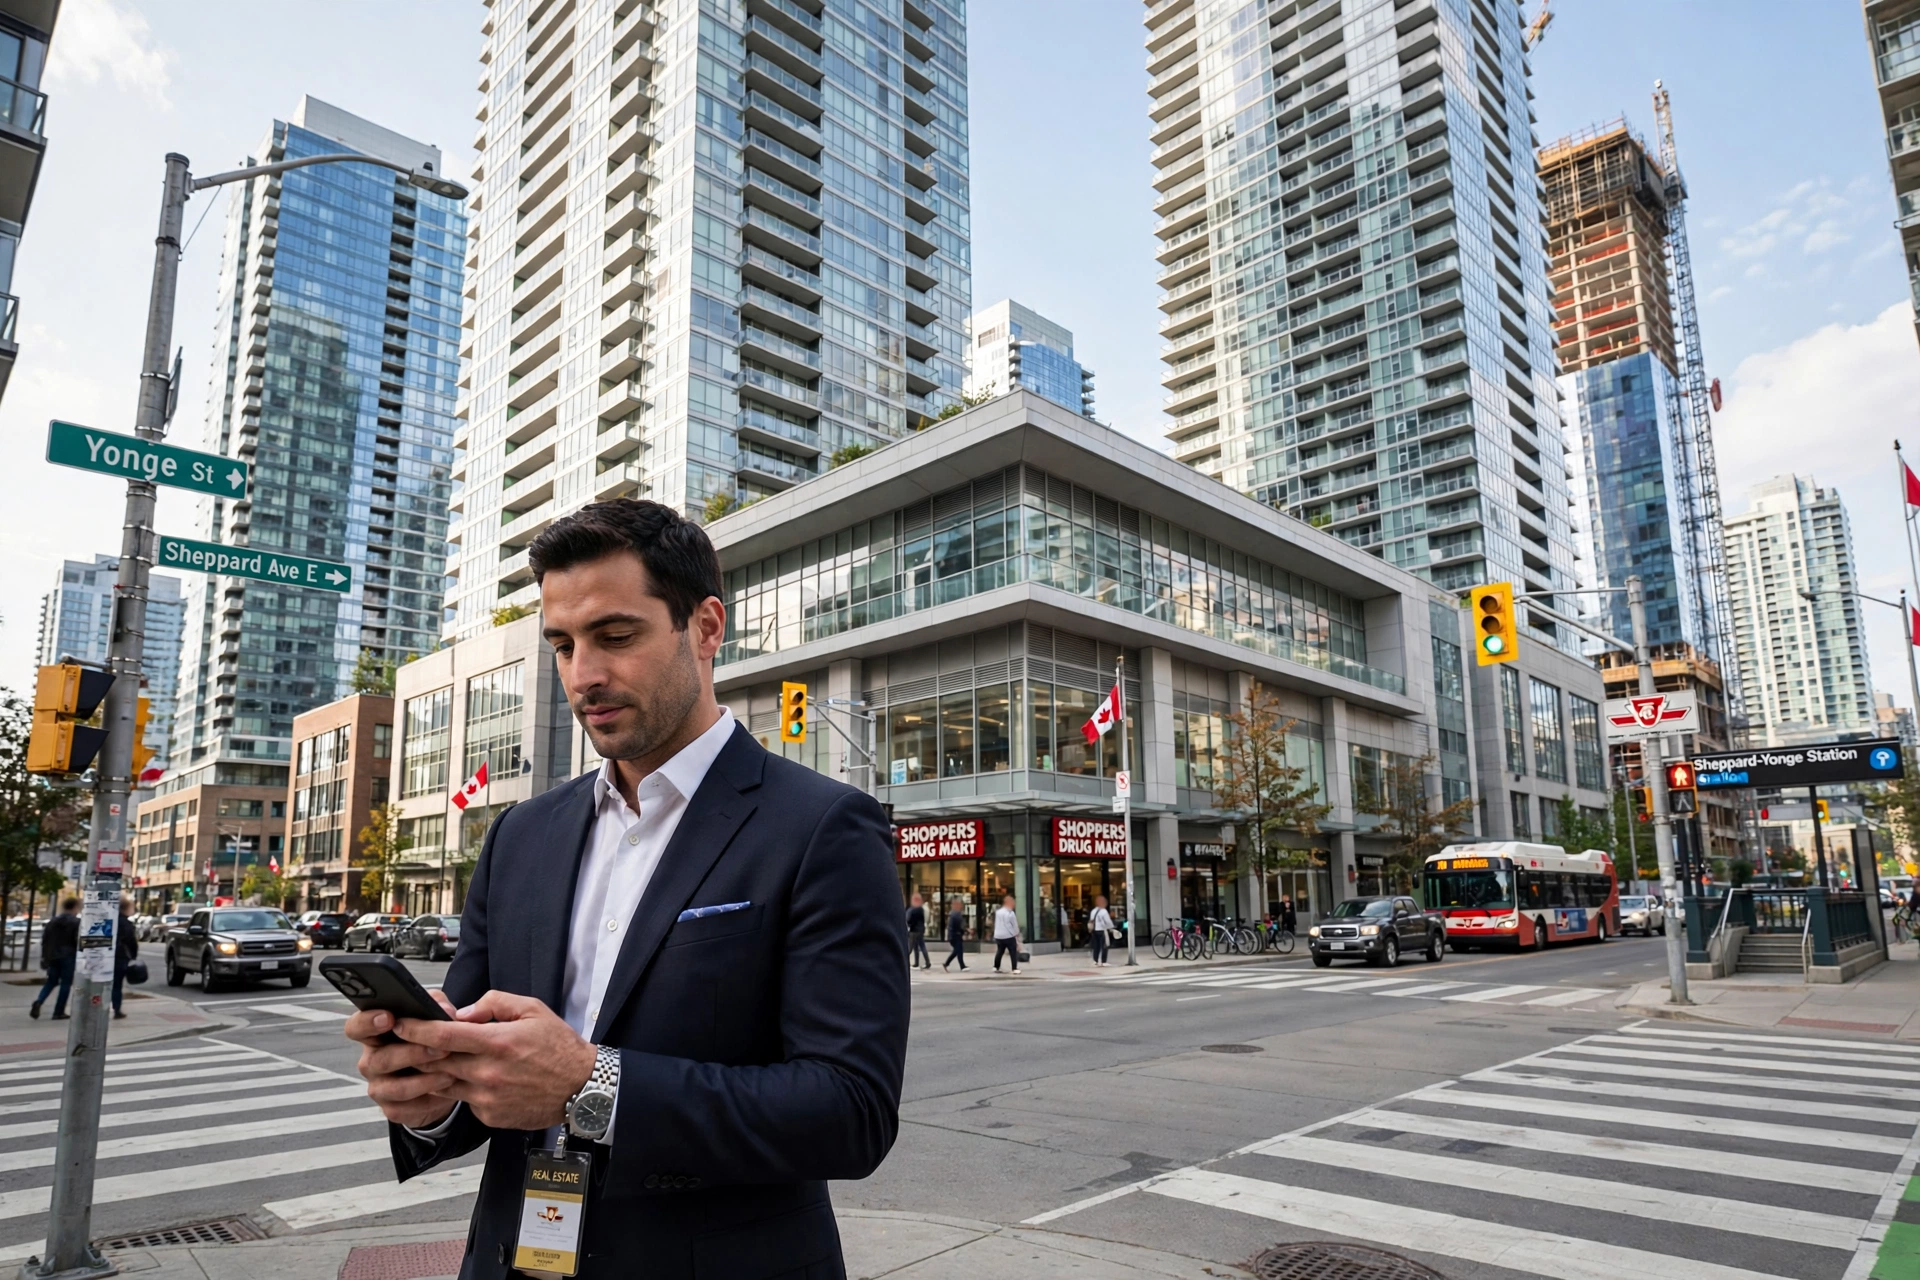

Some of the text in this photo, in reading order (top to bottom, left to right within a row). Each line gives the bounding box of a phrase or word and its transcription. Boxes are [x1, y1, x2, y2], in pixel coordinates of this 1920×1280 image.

[85, 434, 214, 484] Yonge St
[165, 541, 318, 582] Sheppard Ave E
[1694, 748, 1857, 773] Sheppard-Yonge Station
[901, 822, 976, 843] SHOPPERS
[1058, 819, 1125, 840] SHOPPERS
[901, 840, 976, 859] DRUG MART
[1059, 838, 1126, 856] DRUG MART
[532, 1169, 579, 1184] REAL ESTATE
